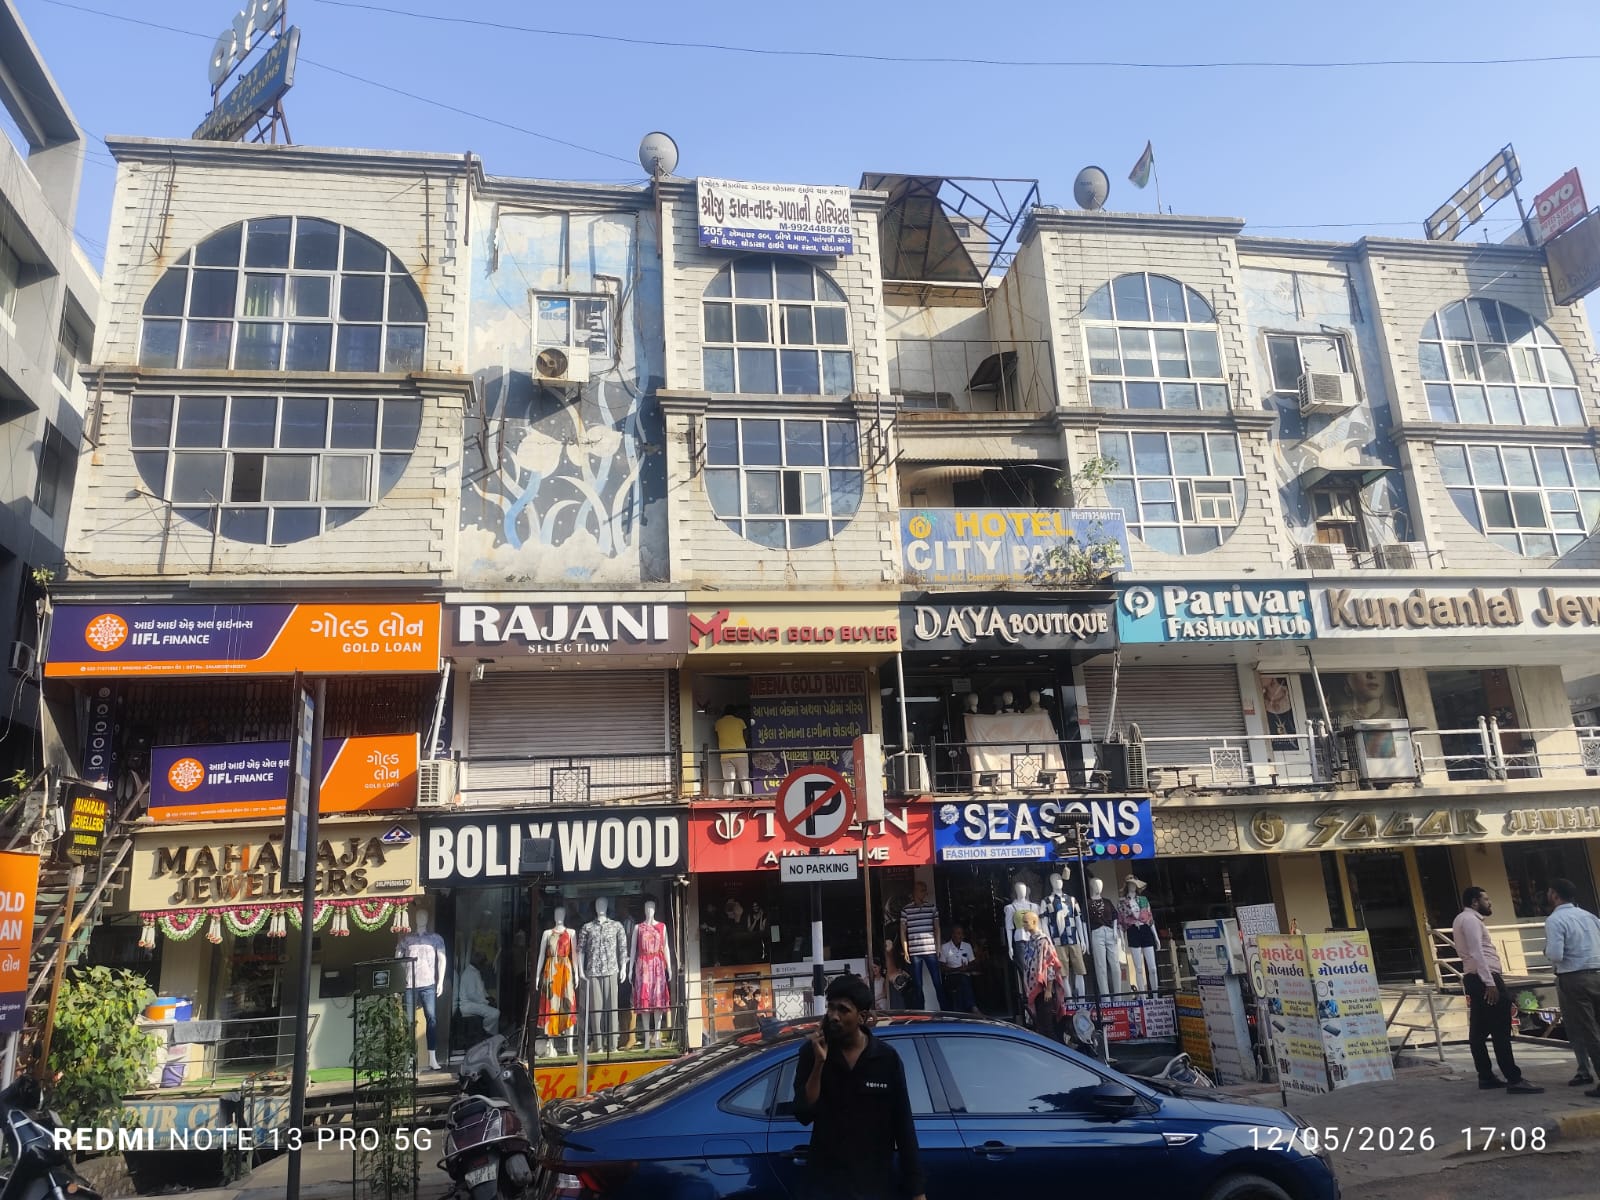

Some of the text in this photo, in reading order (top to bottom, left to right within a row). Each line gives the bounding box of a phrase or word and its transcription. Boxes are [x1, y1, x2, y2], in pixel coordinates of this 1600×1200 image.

[1538, 184, 1574, 216] OYO
[703, 226, 726, 238] 205,
[954, 511, 1075, 538] HOTEL
[907, 540, 1001, 571] CITY
[1163, 584, 1306, 616] Parivar
[1326, 587, 1524, 628] Kundanlal
[310, 611, 423, 637] ગોલ્ડ લોન
[458, 605, 668, 641] RAJANI
[914, 605, 1109, 644] DAYA BOUTIQUE
[131, 632, 210, 646] IIFL FINANCE
[788, 626, 836, 643] GOLD
[841, 624, 898, 643] BUYER
[342, 642, 422, 653] GOLD LOAN
[527, 643, 610, 654] SELECTION
[367, 750, 399, 765] ગોલ્ડ
[208, 773, 274, 784] IIFL FINANCE
[374, 765, 399, 780] લોન
[946, 847, 1042, 859] FASHION STATEMENT
[789, 862, 849, 875] NO PARKING
[1261, 943, 1304, 961] મહાદેવ
[1311, 941, 1369, 961] મહાદેવ
[1318, 960, 1368, 976] મોબાઈલ
